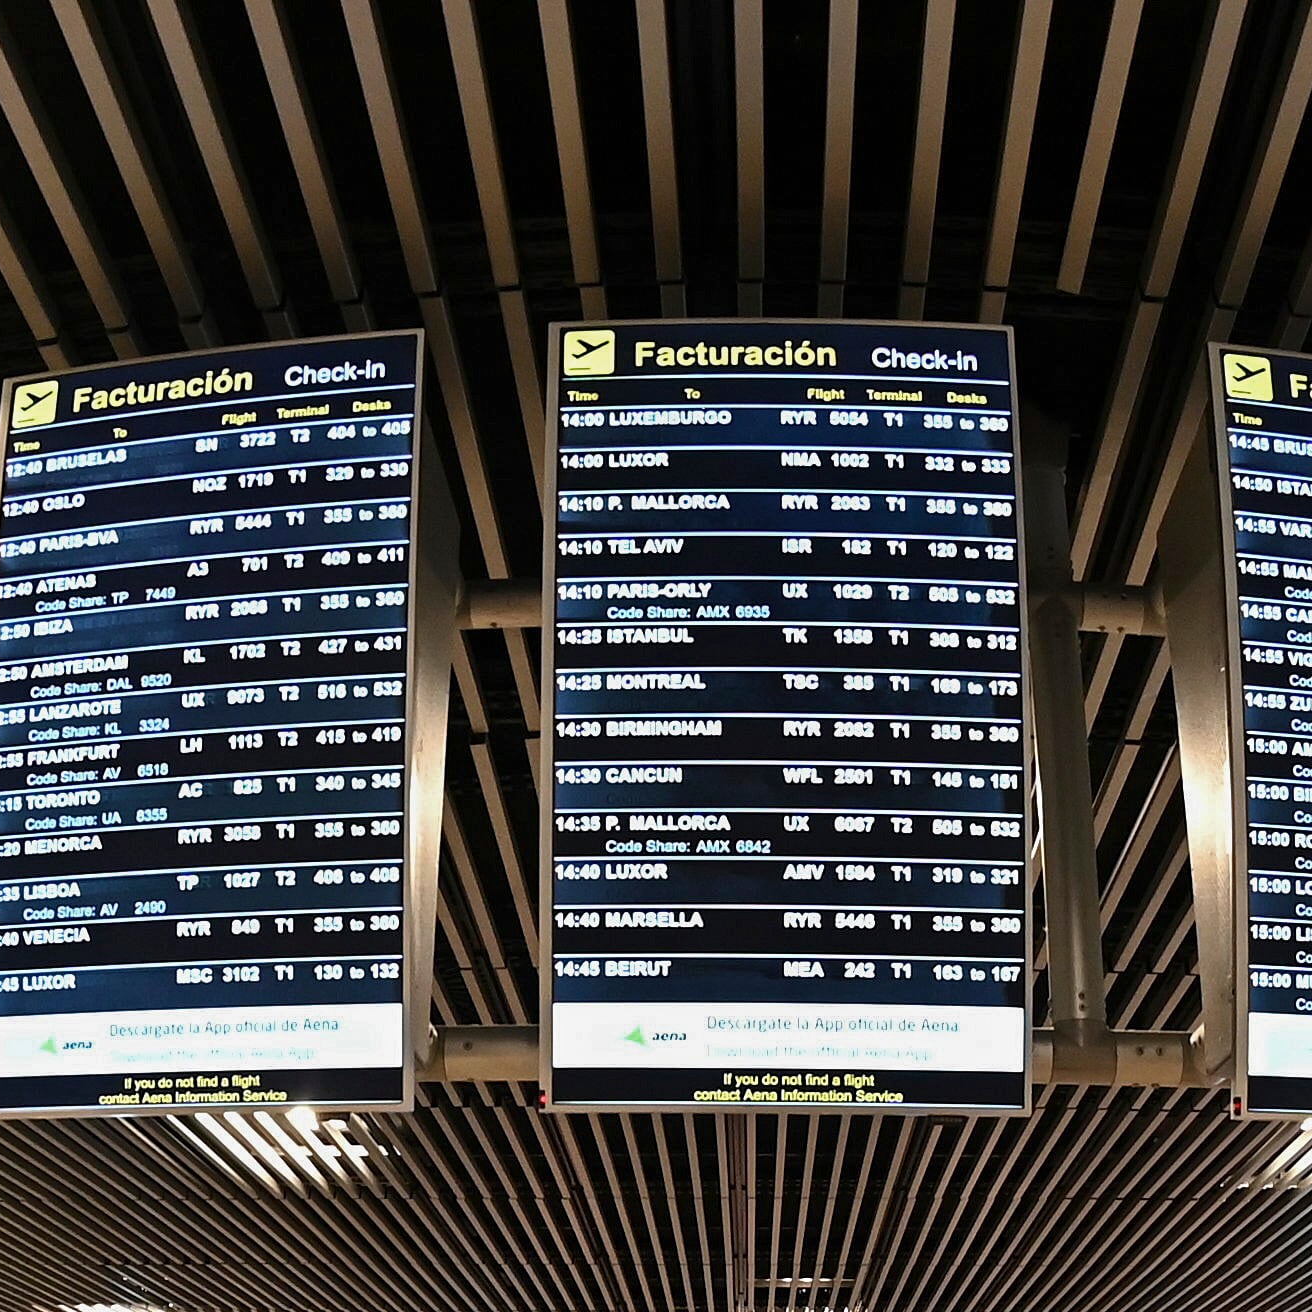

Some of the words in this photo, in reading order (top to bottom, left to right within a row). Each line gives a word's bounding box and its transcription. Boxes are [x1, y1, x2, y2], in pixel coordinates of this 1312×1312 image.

[636, 341, 836, 366] Facturación
[872, 348, 977, 371] Check-in
[72, 369, 254, 413] Facturación
[284, 359, 386, 387] Check-in
[567, 391, 598, 401] Time
[684, 388, 700, 399] To
[807, 388, 845, 401] Flight
[866, 389, 922, 401] Terminal
[947, 392, 987, 404] Desks
[14, 442, 40, 452] Time
[113, 428, 127, 438] To
[222, 412, 256, 425] Flight
[277, 404, 329, 419] Terminal
[353, 400, 391, 412] Desks
[1233, 413, 1262, 425] Time
[561, 454, 603, 468] 14:00
[609, 453, 668, 467] LUXOR
[781, 452, 821, 466] NMA
[831, 453, 869, 467] 1002
[885, 454, 904, 468] T1
[925, 456, 954, 471] 332
[962, 460, 976, 472] to
[1233, 475, 1272, 492] 14:50
[559, 540, 602, 555] 14:10
[607, 539, 641, 554] TEL
[643, 539, 683, 553] AVIV
[782, 539, 812, 553] ISR
[887, 541, 906, 555] T1
[928, 543, 957, 557] 120
[964, 547, 979, 558] to
[985, 545, 1013, 560] 122
[556, 768, 601, 784] 14:30
[606, 768, 682, 783] CANCUN
[783, 768, 823, 783] WFL
[890, 770, 910, 785] T1
[932, 772, 962, 787] 145
[969, 775, 984, 788] to
[606, 840, 642, 852] Code
[646, 840, 690, 852] Share:
[696, 840, 730, 853] AMX
[736, 840, 770, 853] 6842
[23, 974, 76, 991] LUXOR
[223, 966, 259, 982] 3102
[274, 965, 293, 980] T1
[314, 965, 342, 980] 130
[350, 967, 364, 979] to
[371, 963, 399, 978] 132
[555, 961, 600, 976] 14:45
[605, 961, 671, 976] BEIRUT
[784, 961, 824, 977] MEA
[891, 963, 911, 978] T1
[970, 968, 985, 981] to
[723, 1073, 731, 1086] If
[735, 1076, 758, 1087] you
[762, 1073, 778, 1085] do
[782, 1074, 802, 1085] not
[805, 1074, 828, 1086] find
[832, 1077, 840, 1086] a
[844, 1074, 874, 1089] flight
[694, 1089, 740, 1100] contact
[743, 1089, 777, 1100] Aena
[781, 1089, 852, 1101] Information
[856, 1090, 903, 1102] Service
